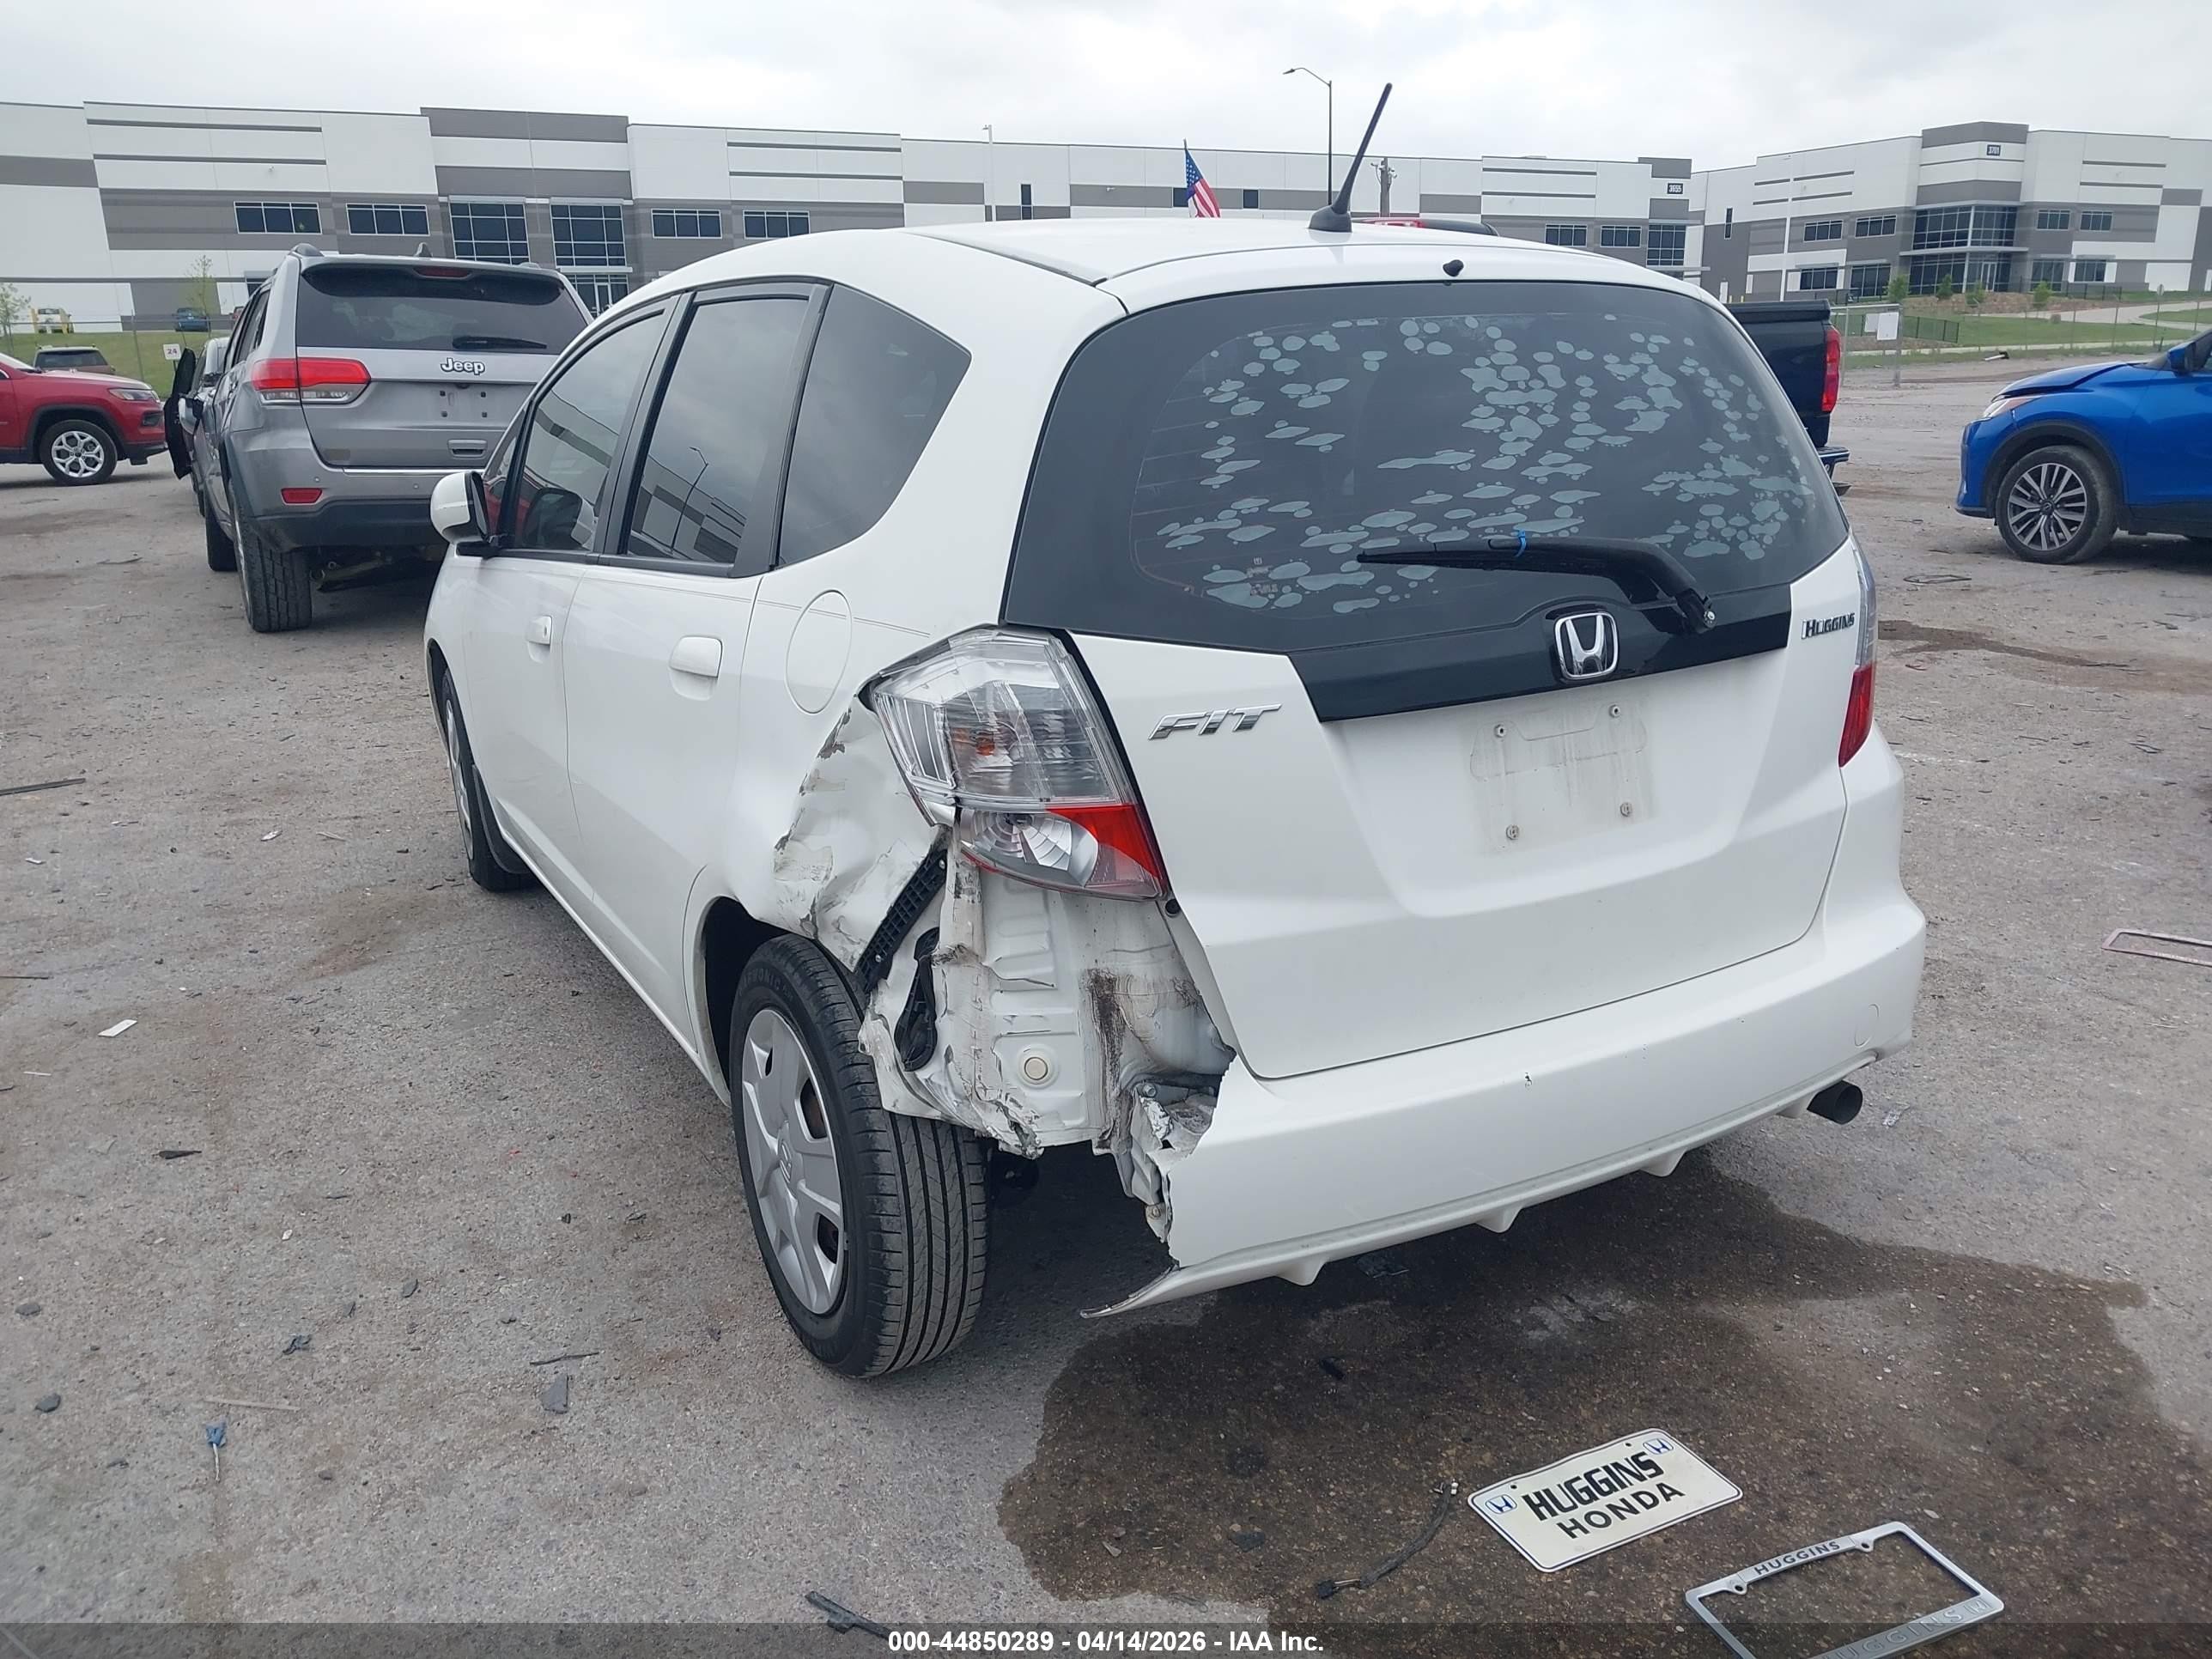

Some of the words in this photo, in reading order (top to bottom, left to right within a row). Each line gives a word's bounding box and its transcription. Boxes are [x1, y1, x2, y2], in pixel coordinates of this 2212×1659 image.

[441, 357, 486, 376] Jeep
[1802, 612, 1855, 639] HUGGINS
[1148, 702, 1282, 740] FIT
[1522, 1451, 1664, 1521] HUGGINS
[1556, 1482, 1686, 1540] HONDA
[1754, 1541, 1840, 1575] HUGGINS
[1822, 1609, 1963, 1659] UGGINS
